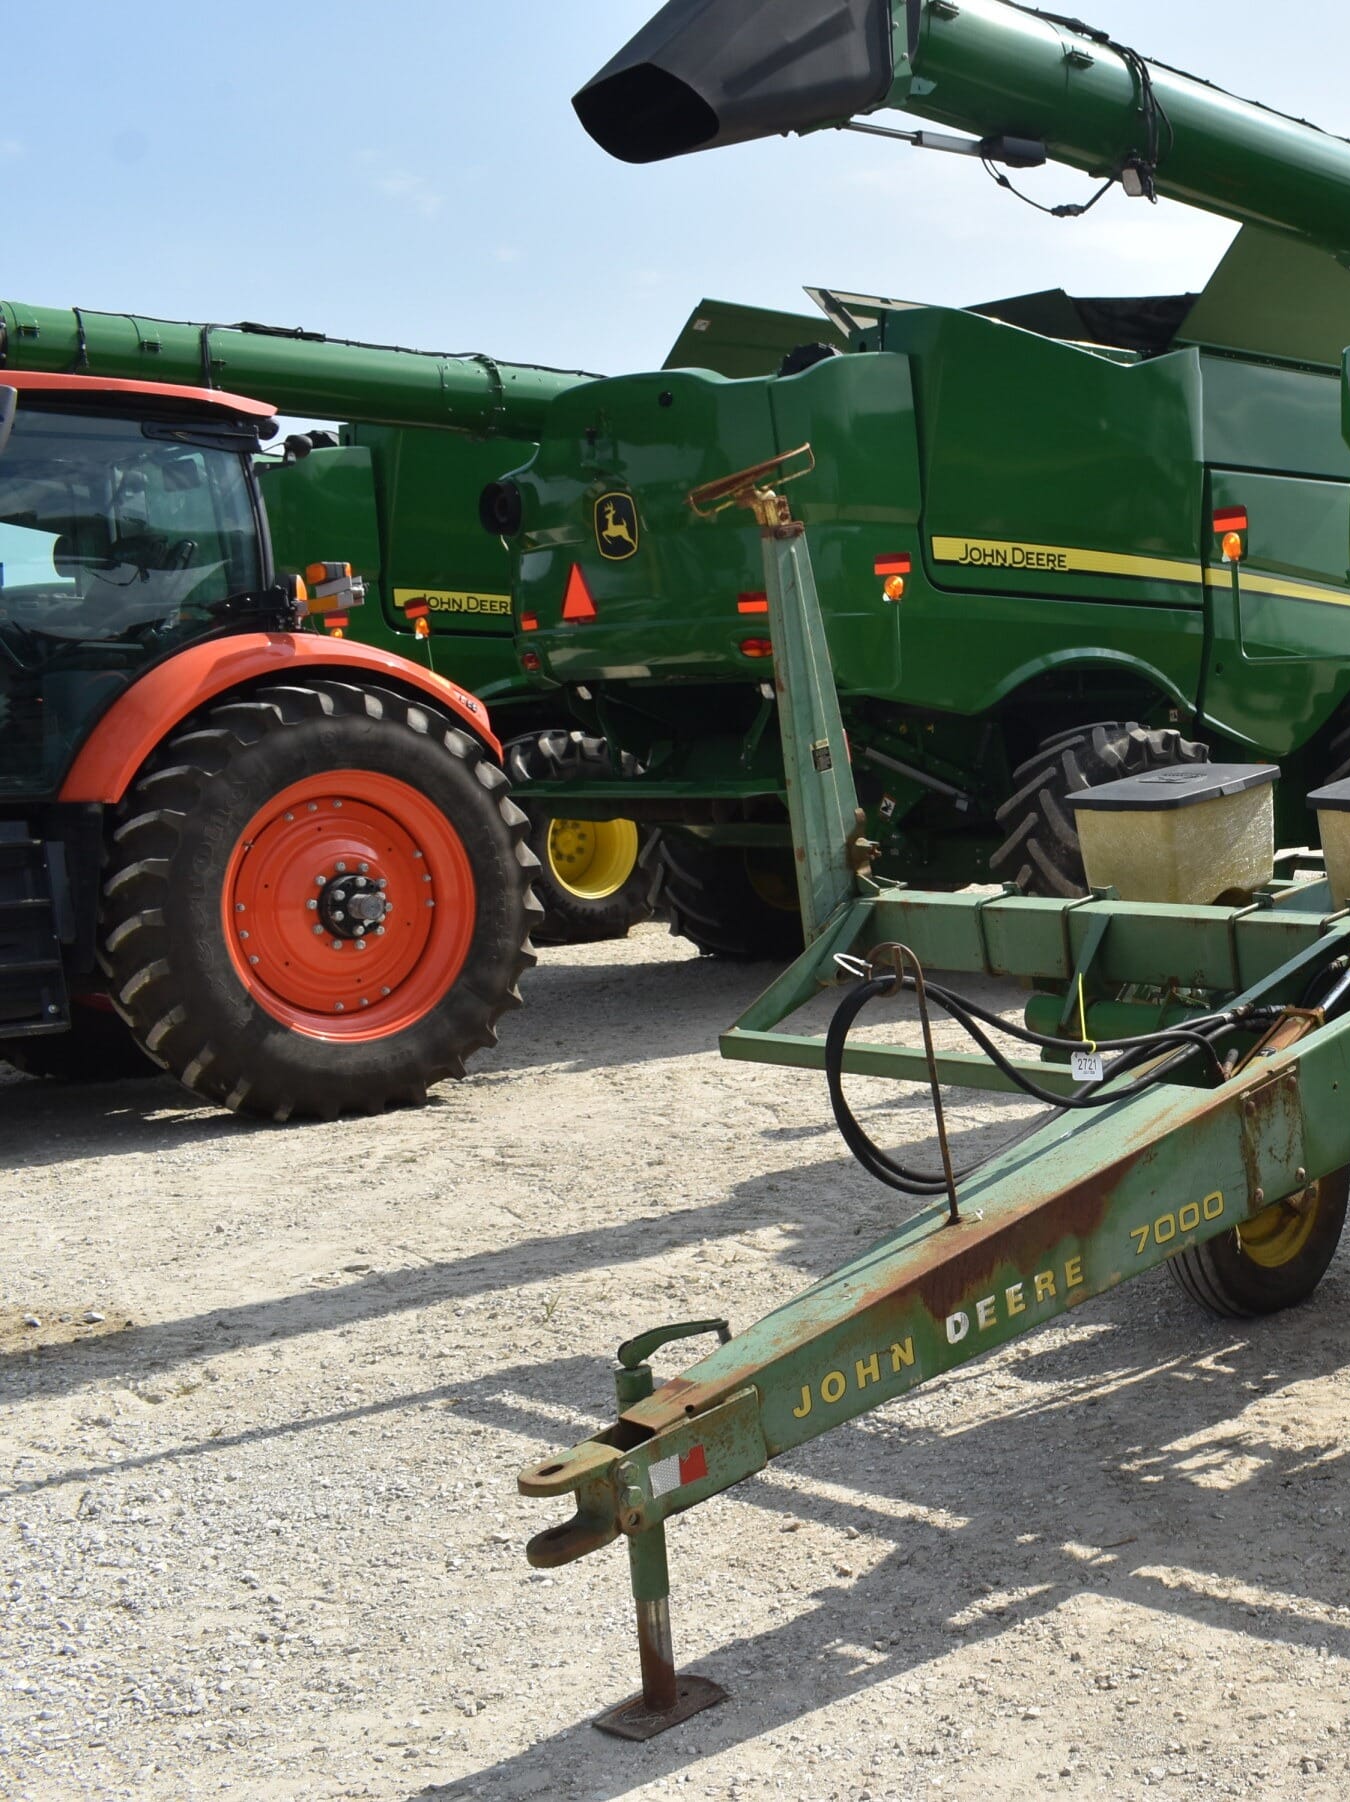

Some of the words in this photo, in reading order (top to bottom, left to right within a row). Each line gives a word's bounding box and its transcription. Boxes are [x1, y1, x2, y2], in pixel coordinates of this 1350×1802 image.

[959, 543, 1007, 564] JOHN
[1011, 547, 1067, 568] DEERE
[423, 593, 463, 611] OHN
[466, 596, 511, 612] DEER
[1077, 1058, 1096, 1071] 2721
[792, 1336, 916, 1419] JOHN
[945, 1256, 1085, 1345] DEERE
[1129, 1191, 1225, 1255] 7000
